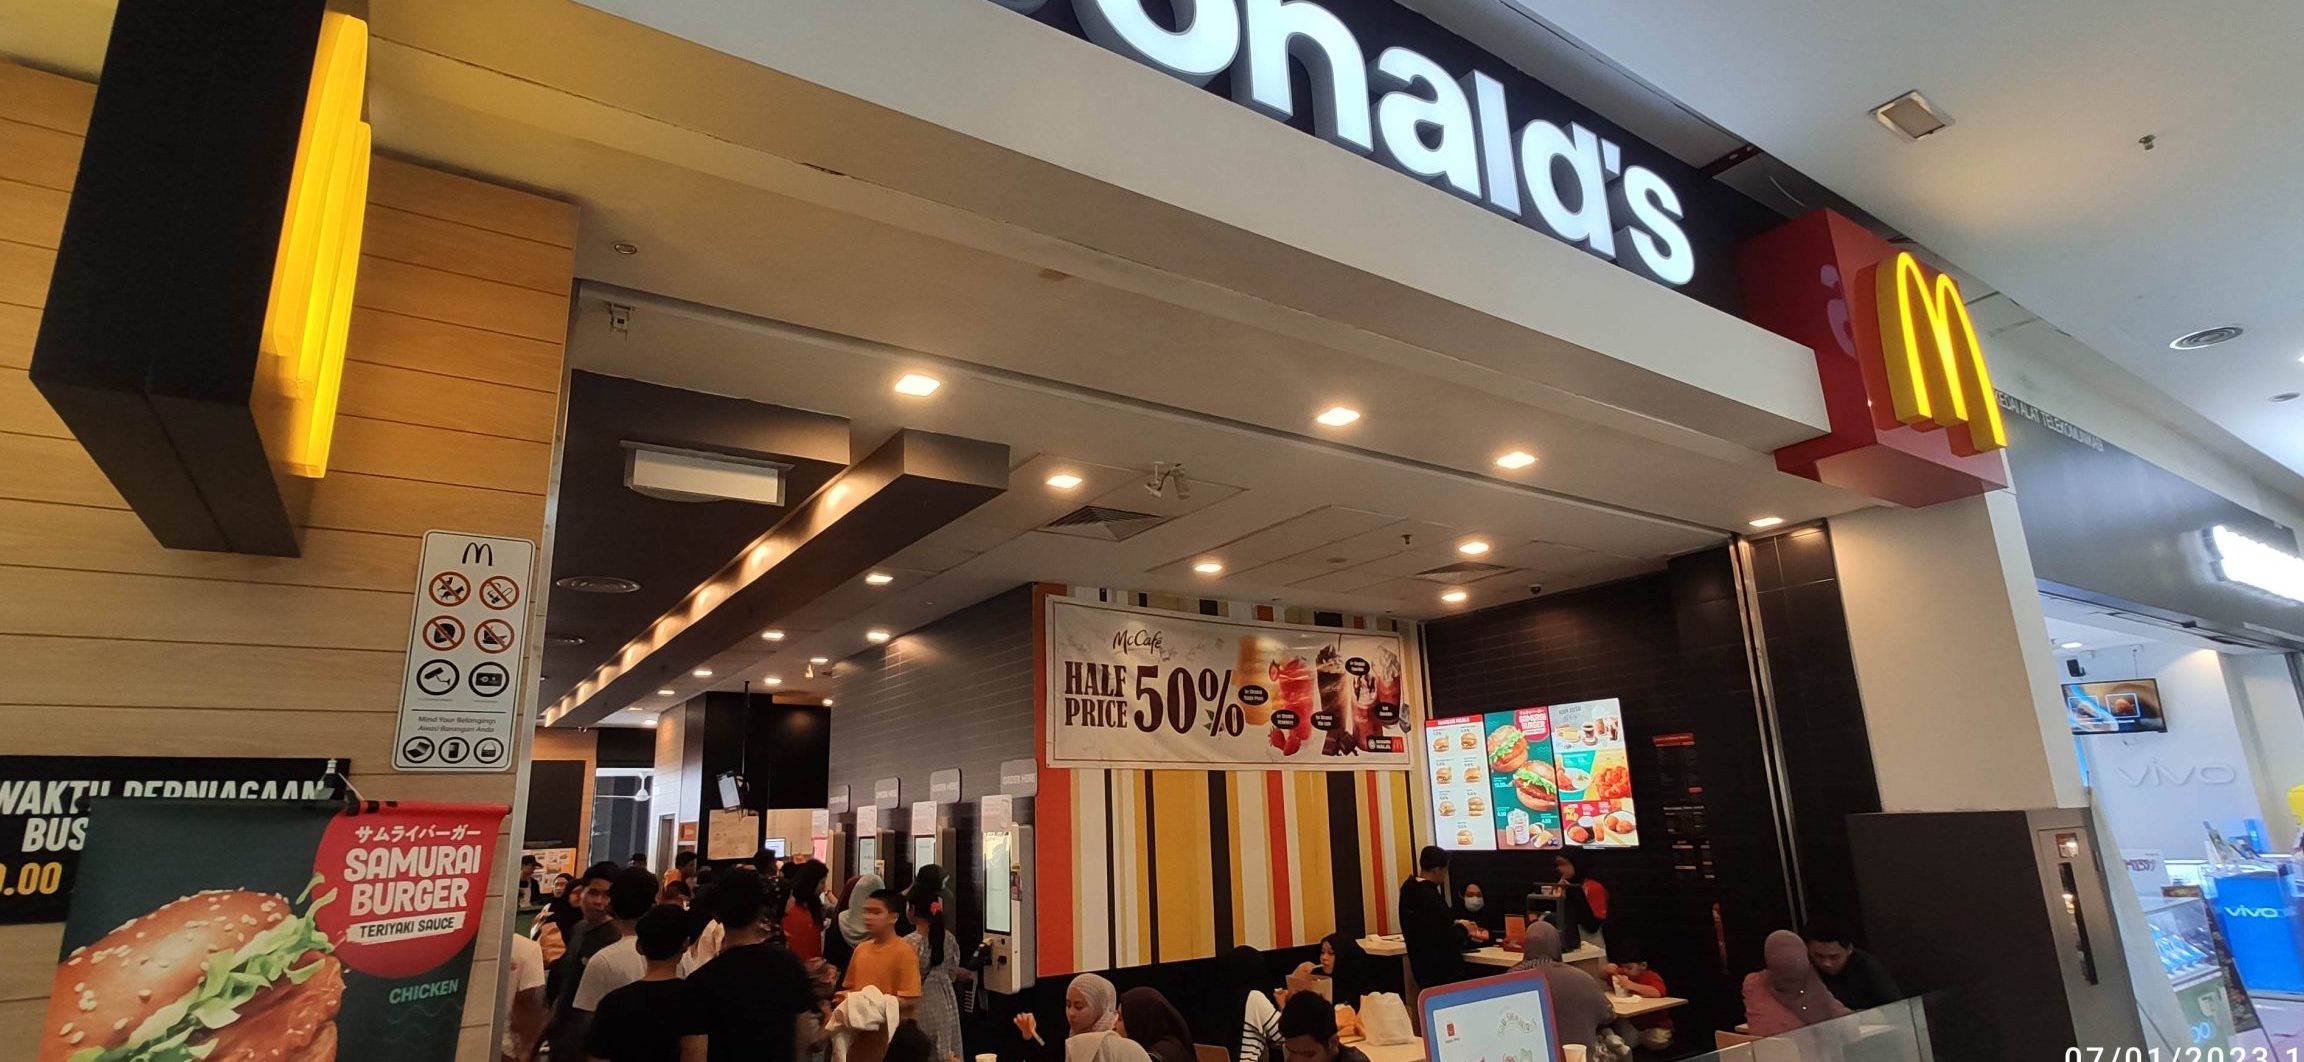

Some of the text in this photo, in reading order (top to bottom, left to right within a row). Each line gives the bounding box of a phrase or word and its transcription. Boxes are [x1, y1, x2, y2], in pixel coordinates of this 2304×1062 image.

[1112, 629, 1163, 655] McCafé
[1064, 660, 1245, 737] HALF 50%
[1064, 697, 1128, 728] PRICE
[2117, 758, 2238, 788] vivo
[21, 816, 89, 853] BUS
[355, 824, 482, 844] サムライバーガー
[343, 844, 482, 882] SAMURAI
[350, 877, 470, 916] BURGER
[2223, 904, 2280, 918] vivo
[359, 916, 455, 938] TERIYAKI SAUCE
[388, 978, 459, 1004] CHICKEN
